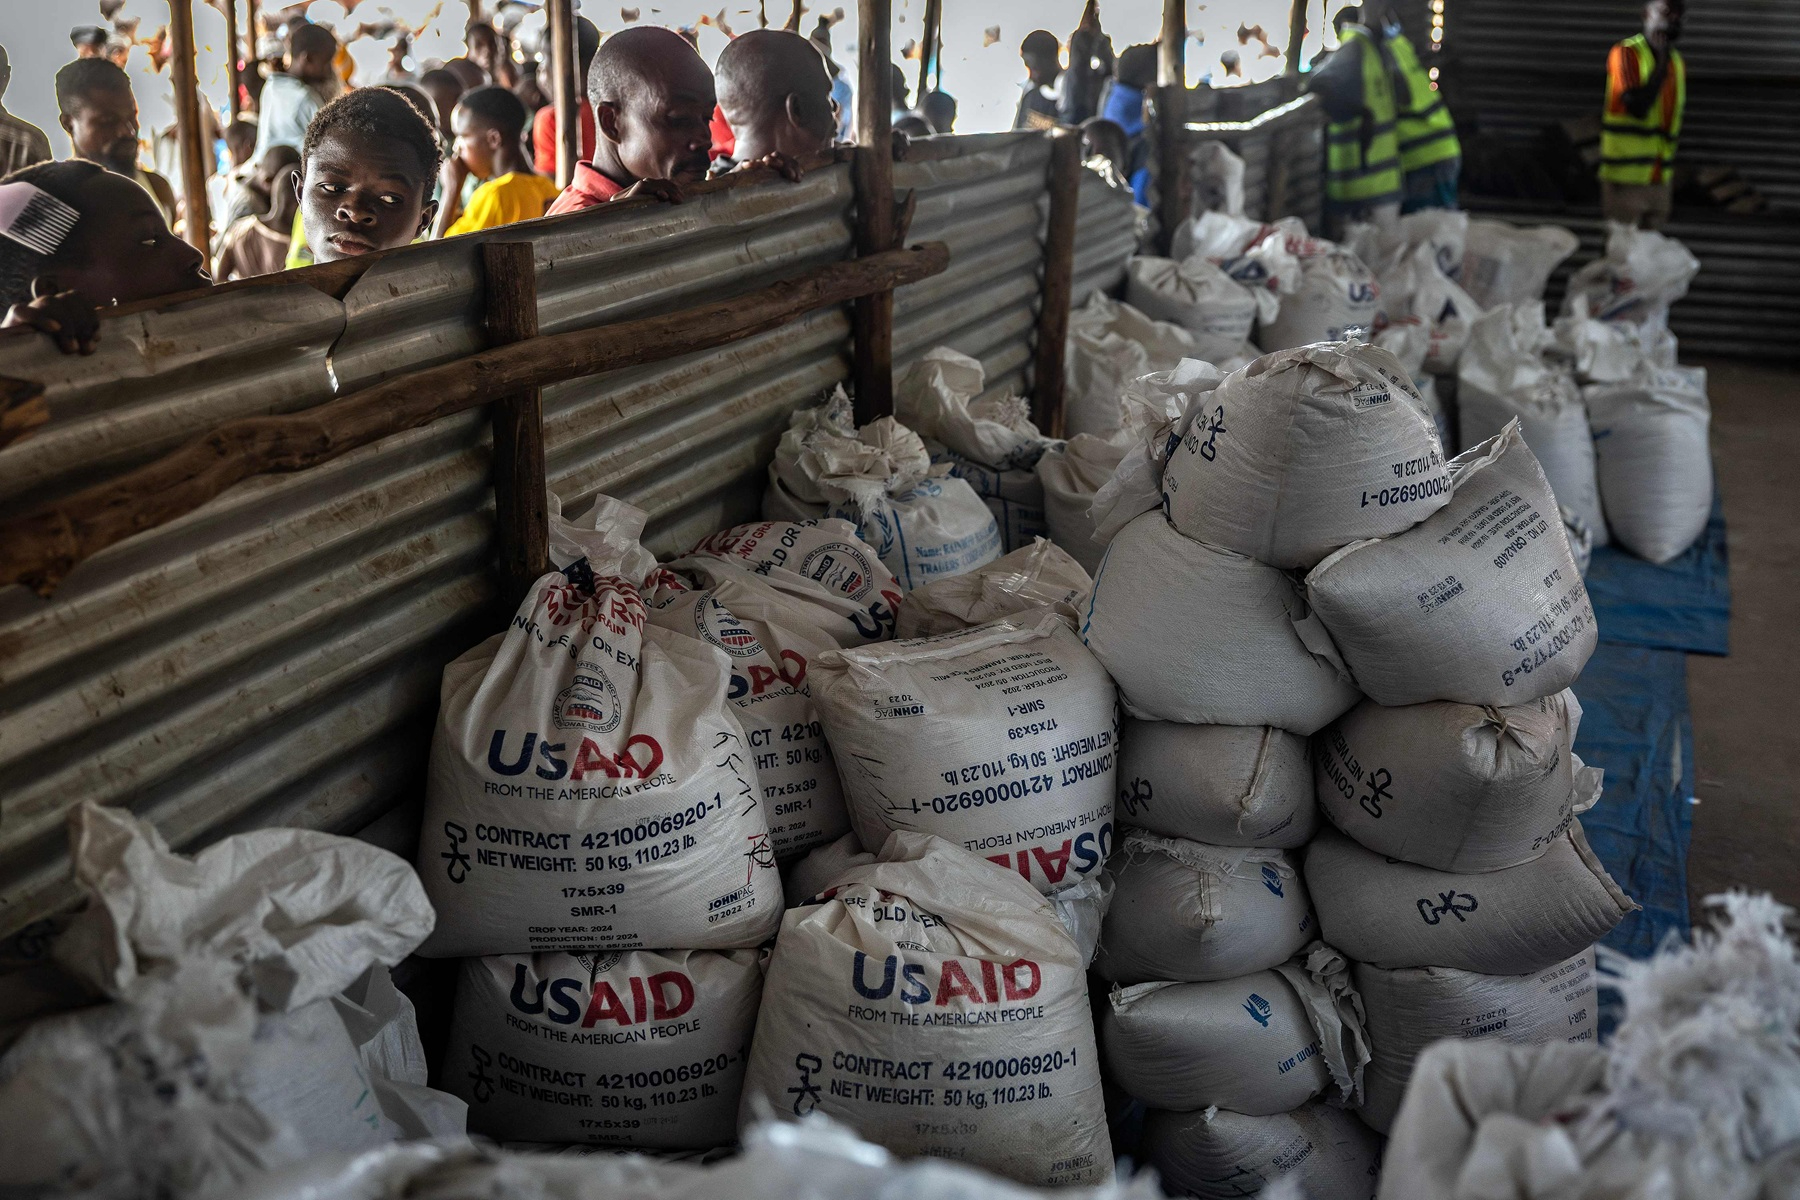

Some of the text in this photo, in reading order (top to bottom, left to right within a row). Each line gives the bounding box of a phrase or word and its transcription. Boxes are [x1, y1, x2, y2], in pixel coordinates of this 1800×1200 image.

[1537, 520, 1549, 534] LOT
[1494, 536, 1527, 568] CRA2409
[970, 658, 1006, 675] FARMERS
[996, 666, 1011, 674] BY:
[1009, 665, 1061, 682] PRODUCTION:
[1011, 662, 1034, 671] USED
[975, 680, 995, 690] 2024
[1002, 673, 1068, 695] CROP YEAR: 2024
[875, 705, 925, 718] JOHNPAC
[1007, 699, 1045, 717] SMR-1
[1008, 718, 1058, 740] 17x5x39
[787, 751, 802, 765] 50
[941, 731, 1112, 786] NET WEIGHT: 50 kg, 110.23 lb.
[1344, 754, 1364, 782] NET
[484, 773, 677, 800] FROM THE AMERICAN PEOPLE
[763, 778, 817, 798] 17x5x39
[911, 755, 1112, 814] CONTRACT 4210006920-1
[775, 798, 812, 816] SMR-1
[475, 792, 723, 850] CONTRACT 4210006920-1
[788, 820, 806, 831] 2024
[1079, 811, 1096, 827] THE
[1016, 817, 1077, 843] AMERICAN
[964, 832, 1012, 850] PEOPLE
[477, 832, 697, 873] NET WEIGHT: 50 kg, 110.23 lb.
[561, 883, 625, 898] 17x5x39
[708, 884, 755, 913] JOHNPAC
[570, 904, 617, 917] SMR-1
[720, 905, 743, 922] 2022
[746, 897, 756, 908] 27
[558, 925, 588, 933] YEAR:
[853, 951, 1042, 1006] USAID
[509, 962, 695, 1028] USAID
[848, 1004, 1044, 1026] FROM THE AMERICAN PEOPLE
[1476, 1012, 1497, 1022] 2022
[506, 1013, 701, 1045] FROM THE AMERICAN PEOPLE
[499, 1047, 747, 1089] CONTRACT 4210006920-1
[833, 1047, 1078, 1081] CONTRACT 4210006920-1
[1277, 1056, 1296, 1076] any
[501, 1074, 719, 1110] NET WEIGHT: 50 kg, 110.23 lb.
[830, 1079, 1053, 1110] NET WEIGHT: 50 kg, 110.23 lb.
[578, 1119, 641, 1129] 17x5x39
[915, 1123, 977, 1136] 17x5x39
[1050, 1155, 1093, 1172] JOHNPAC
